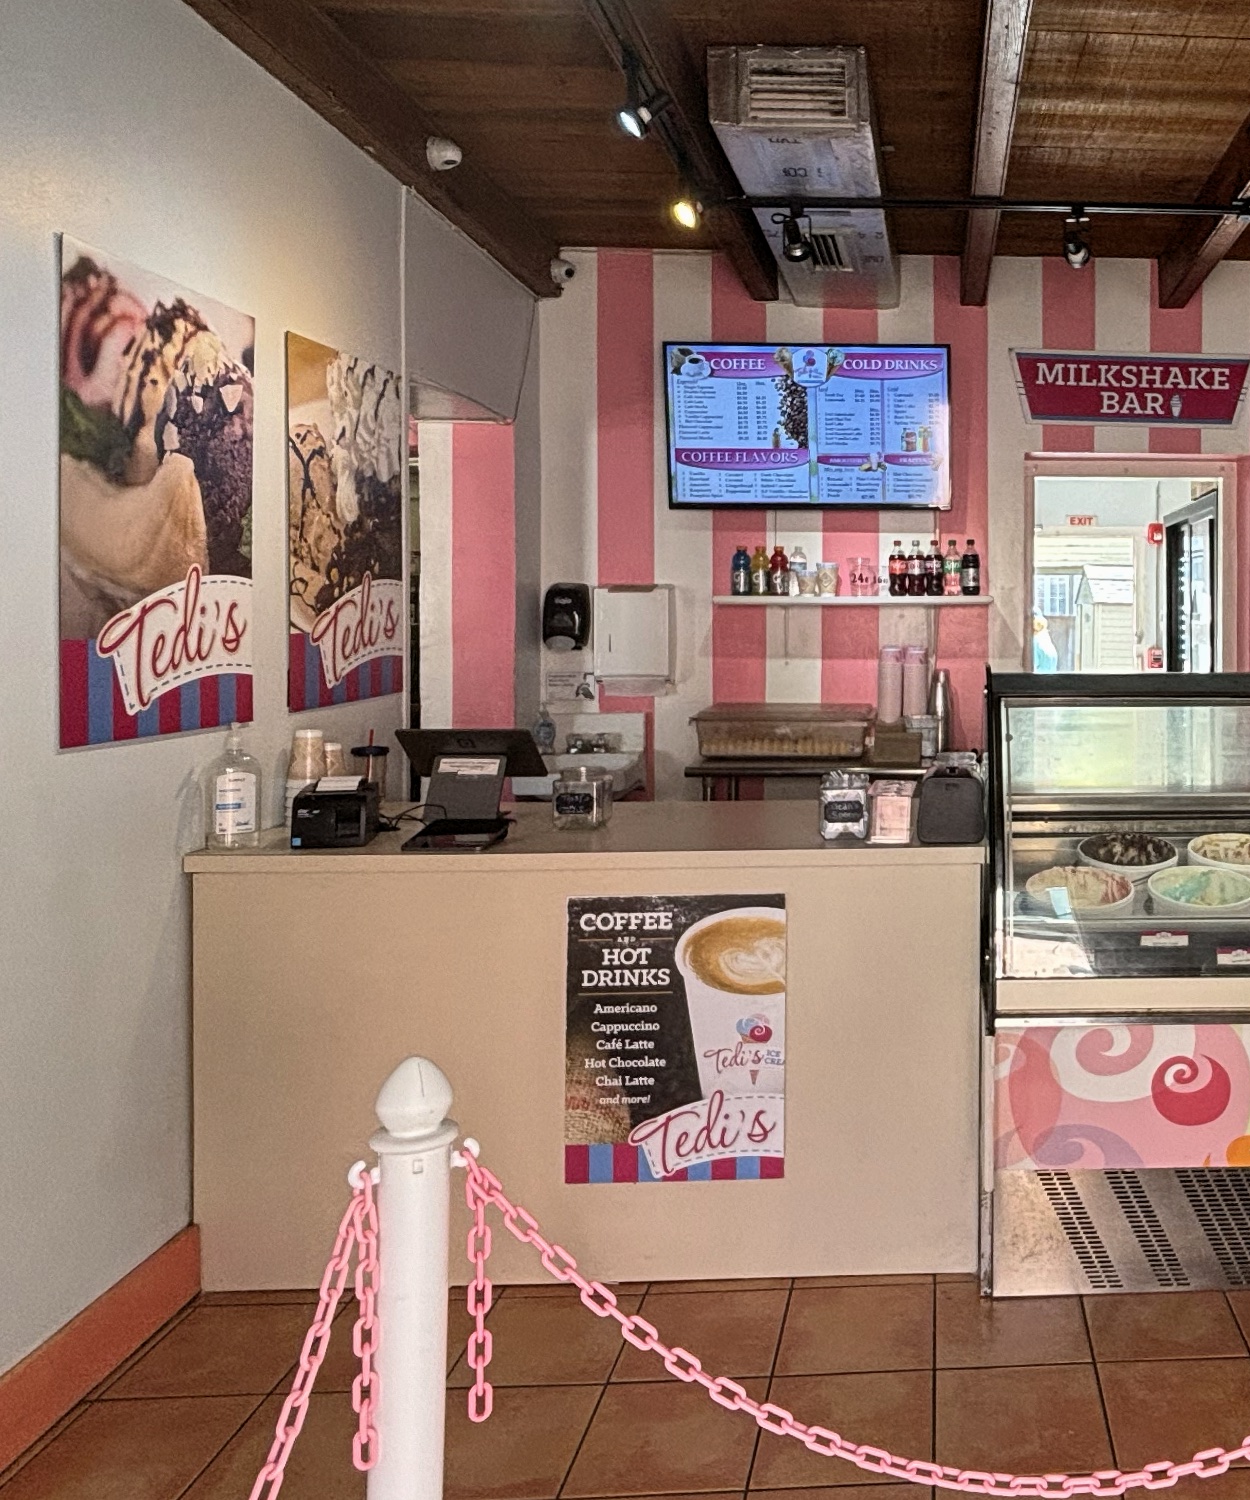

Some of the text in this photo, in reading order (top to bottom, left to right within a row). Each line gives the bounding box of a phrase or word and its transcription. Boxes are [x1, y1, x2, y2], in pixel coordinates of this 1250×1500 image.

[710, 358, 766, 370] COFFEE
[843, 359, 938, 370] COLD DRINKS
[1035, 362, 1230, 390] MILKSHAKE
[1101, 391, 1165, 415] BAR
[681, 451, 798, 464] COFFEE FLAVORS
[1069, 517, 1093, 526] EXIT
[311, 571, 399, 685] Tedi's
[98, 564, 248, 709] Tedi's
[580, 912, 673, 931] COFFEE
[602, 948, 652, 965] HOT
[581, 969, 671, 987] DRINKS
[594, 1003, 658, 1014] Americano
[591, 1021, 660, 1033] Cappuccino
[596, 1038, 655, 1050] Café Latte
[703, 1042, 764, 1075] Tedi's
[766, 1049, 781, 1057] ICE
[584, 1057, 667, 1069] Hot Chocolate
[595, 1075, 655, 1087] Chai Latte
[599, 1094, 651, 1105] and more!
[631, 1089, 777, 1175] Tedi's
